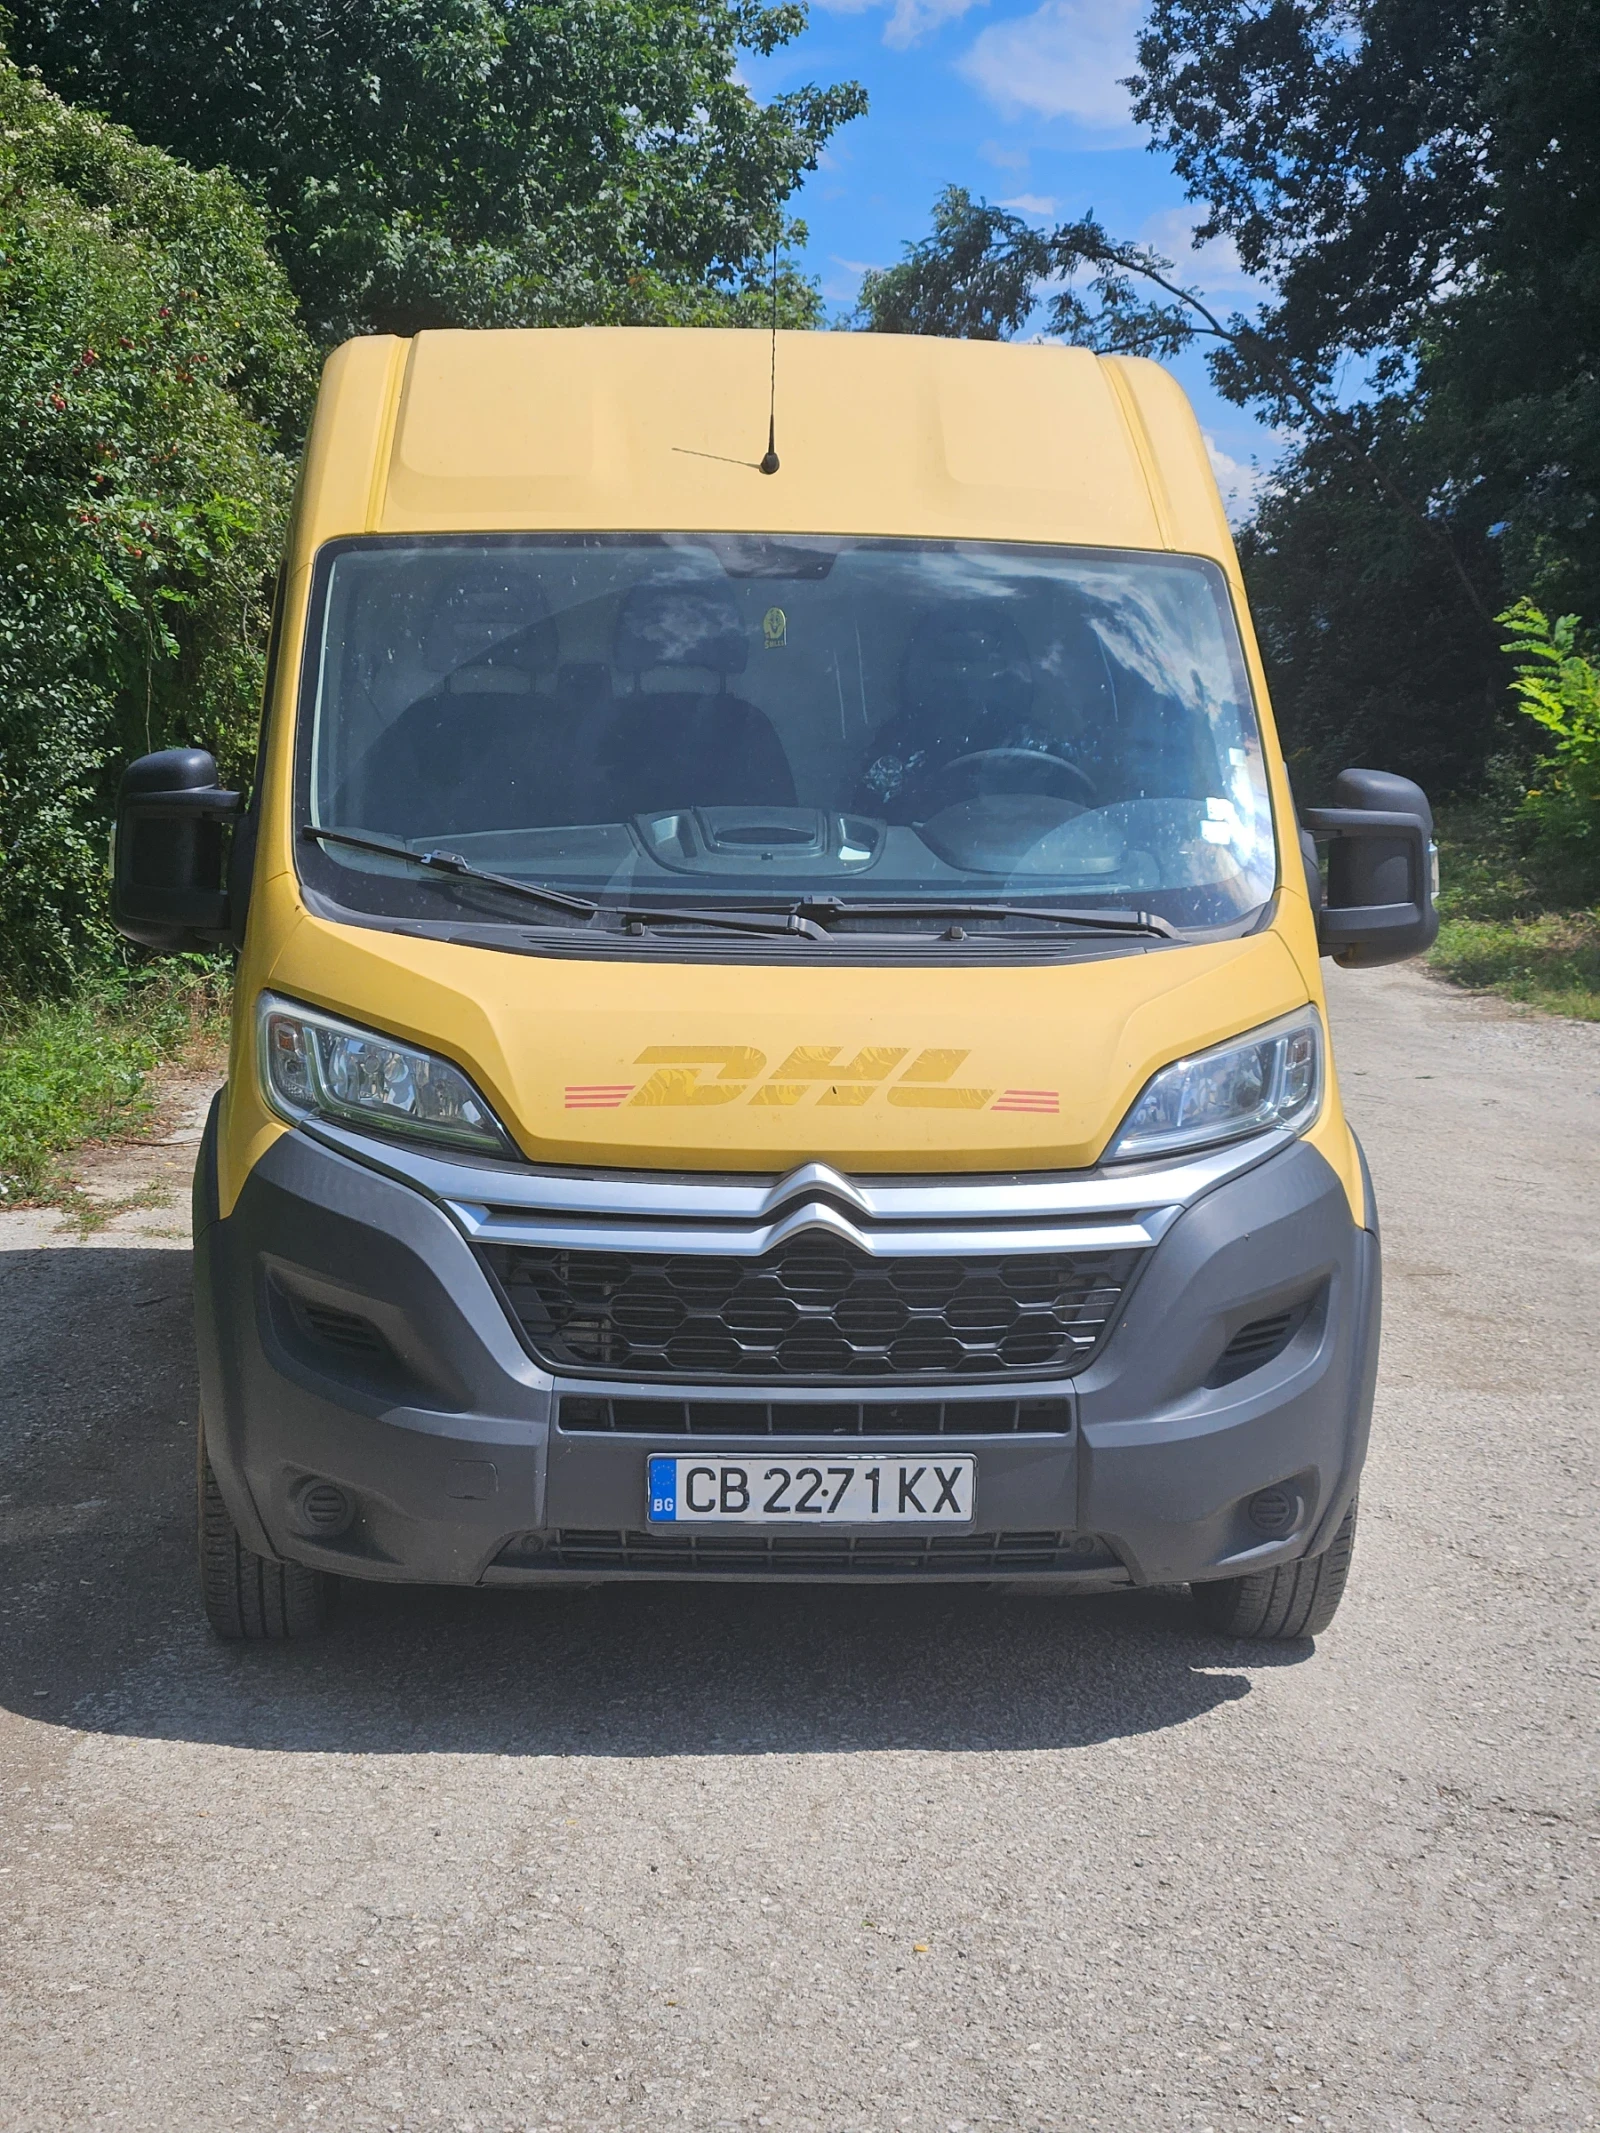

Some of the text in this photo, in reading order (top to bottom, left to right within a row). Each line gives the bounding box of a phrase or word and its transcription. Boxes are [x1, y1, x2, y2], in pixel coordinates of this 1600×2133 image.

[626, 1045, 997, 1109] DHL
[653, 1498, 674, 1512] BG
[686, 1467, 962, 1513] CB 2271 KX
